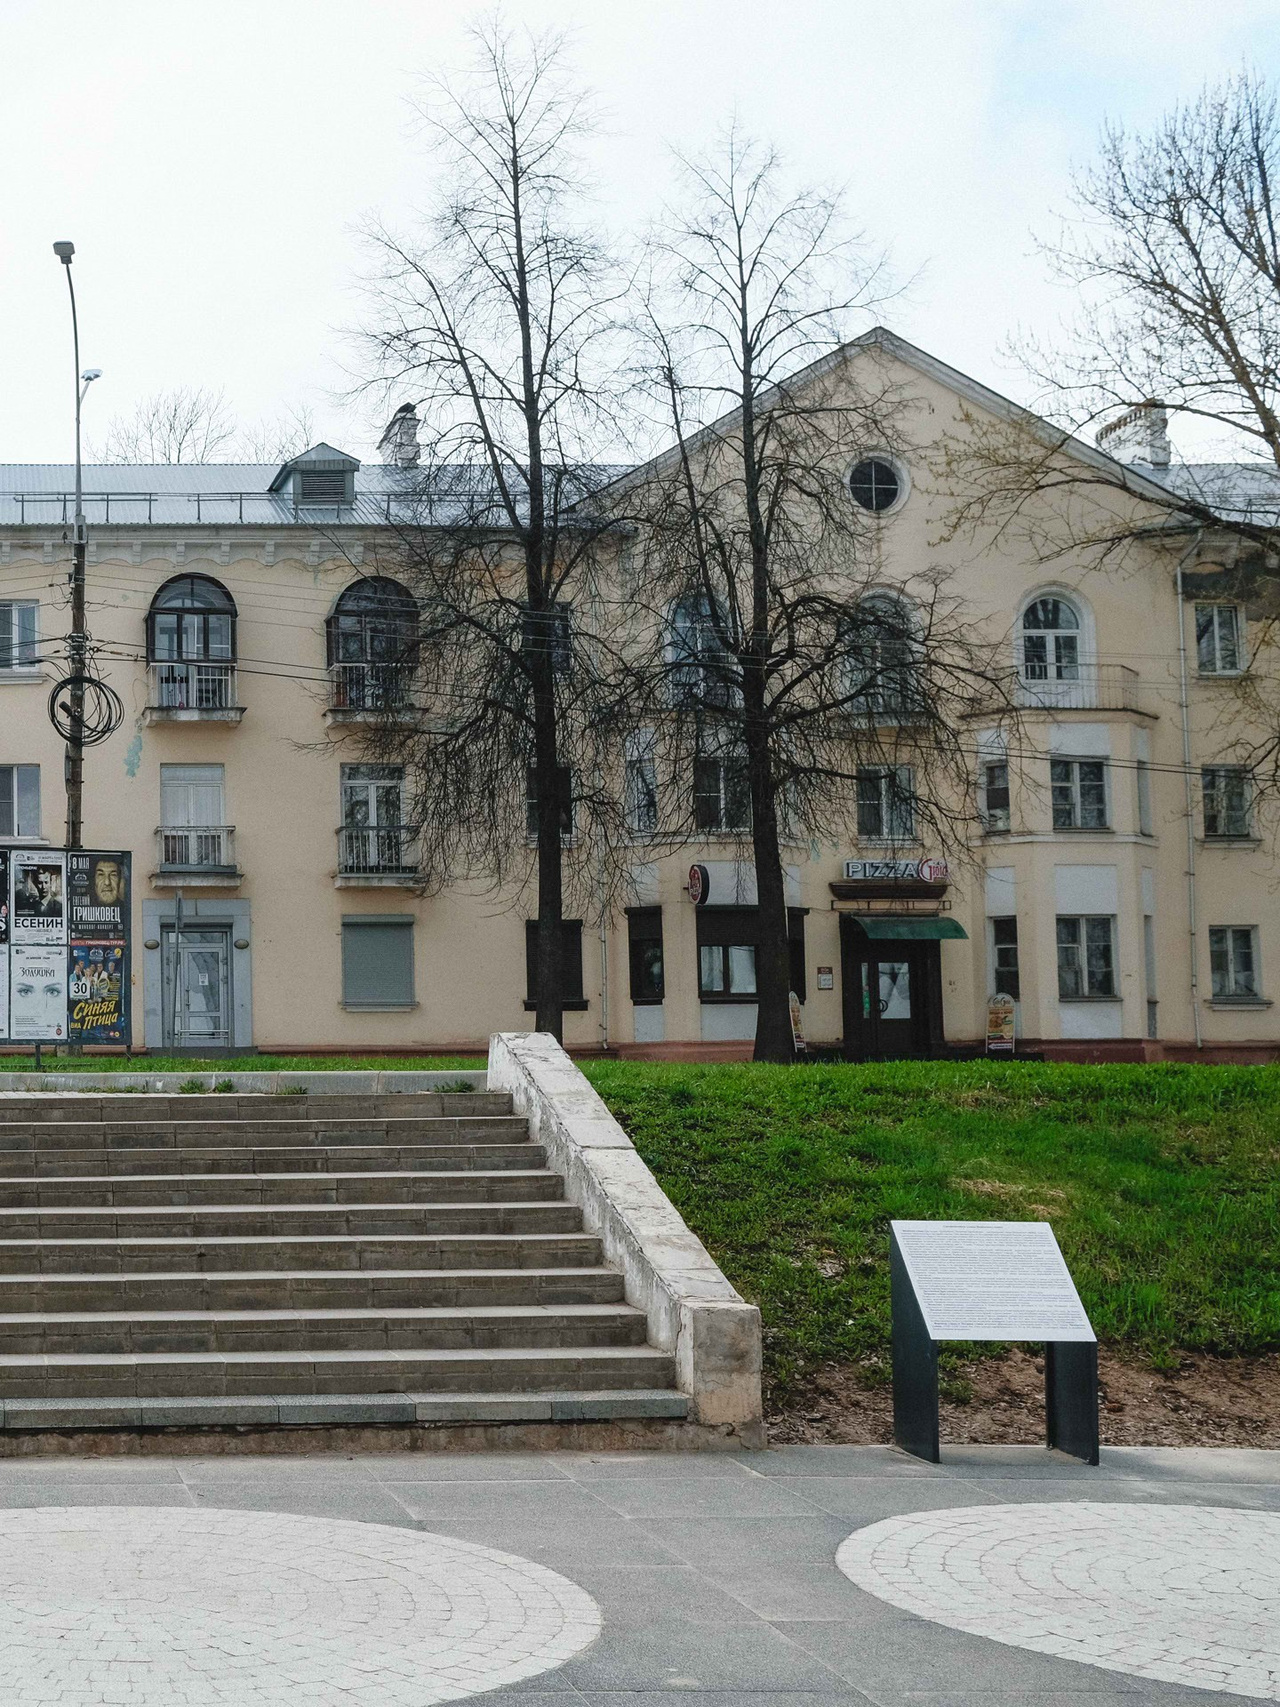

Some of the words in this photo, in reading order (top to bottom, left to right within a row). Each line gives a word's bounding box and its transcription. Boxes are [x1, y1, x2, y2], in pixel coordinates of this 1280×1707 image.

[72, 857, 77, 869] 8
[846, 861, 919, 878] PIZZA
[73, 906, 121, 923] ГРИШКОВЕЦ
[14, 918, 63, 928] ЕСЕНИН
[73, 982, 88, 994] 30
